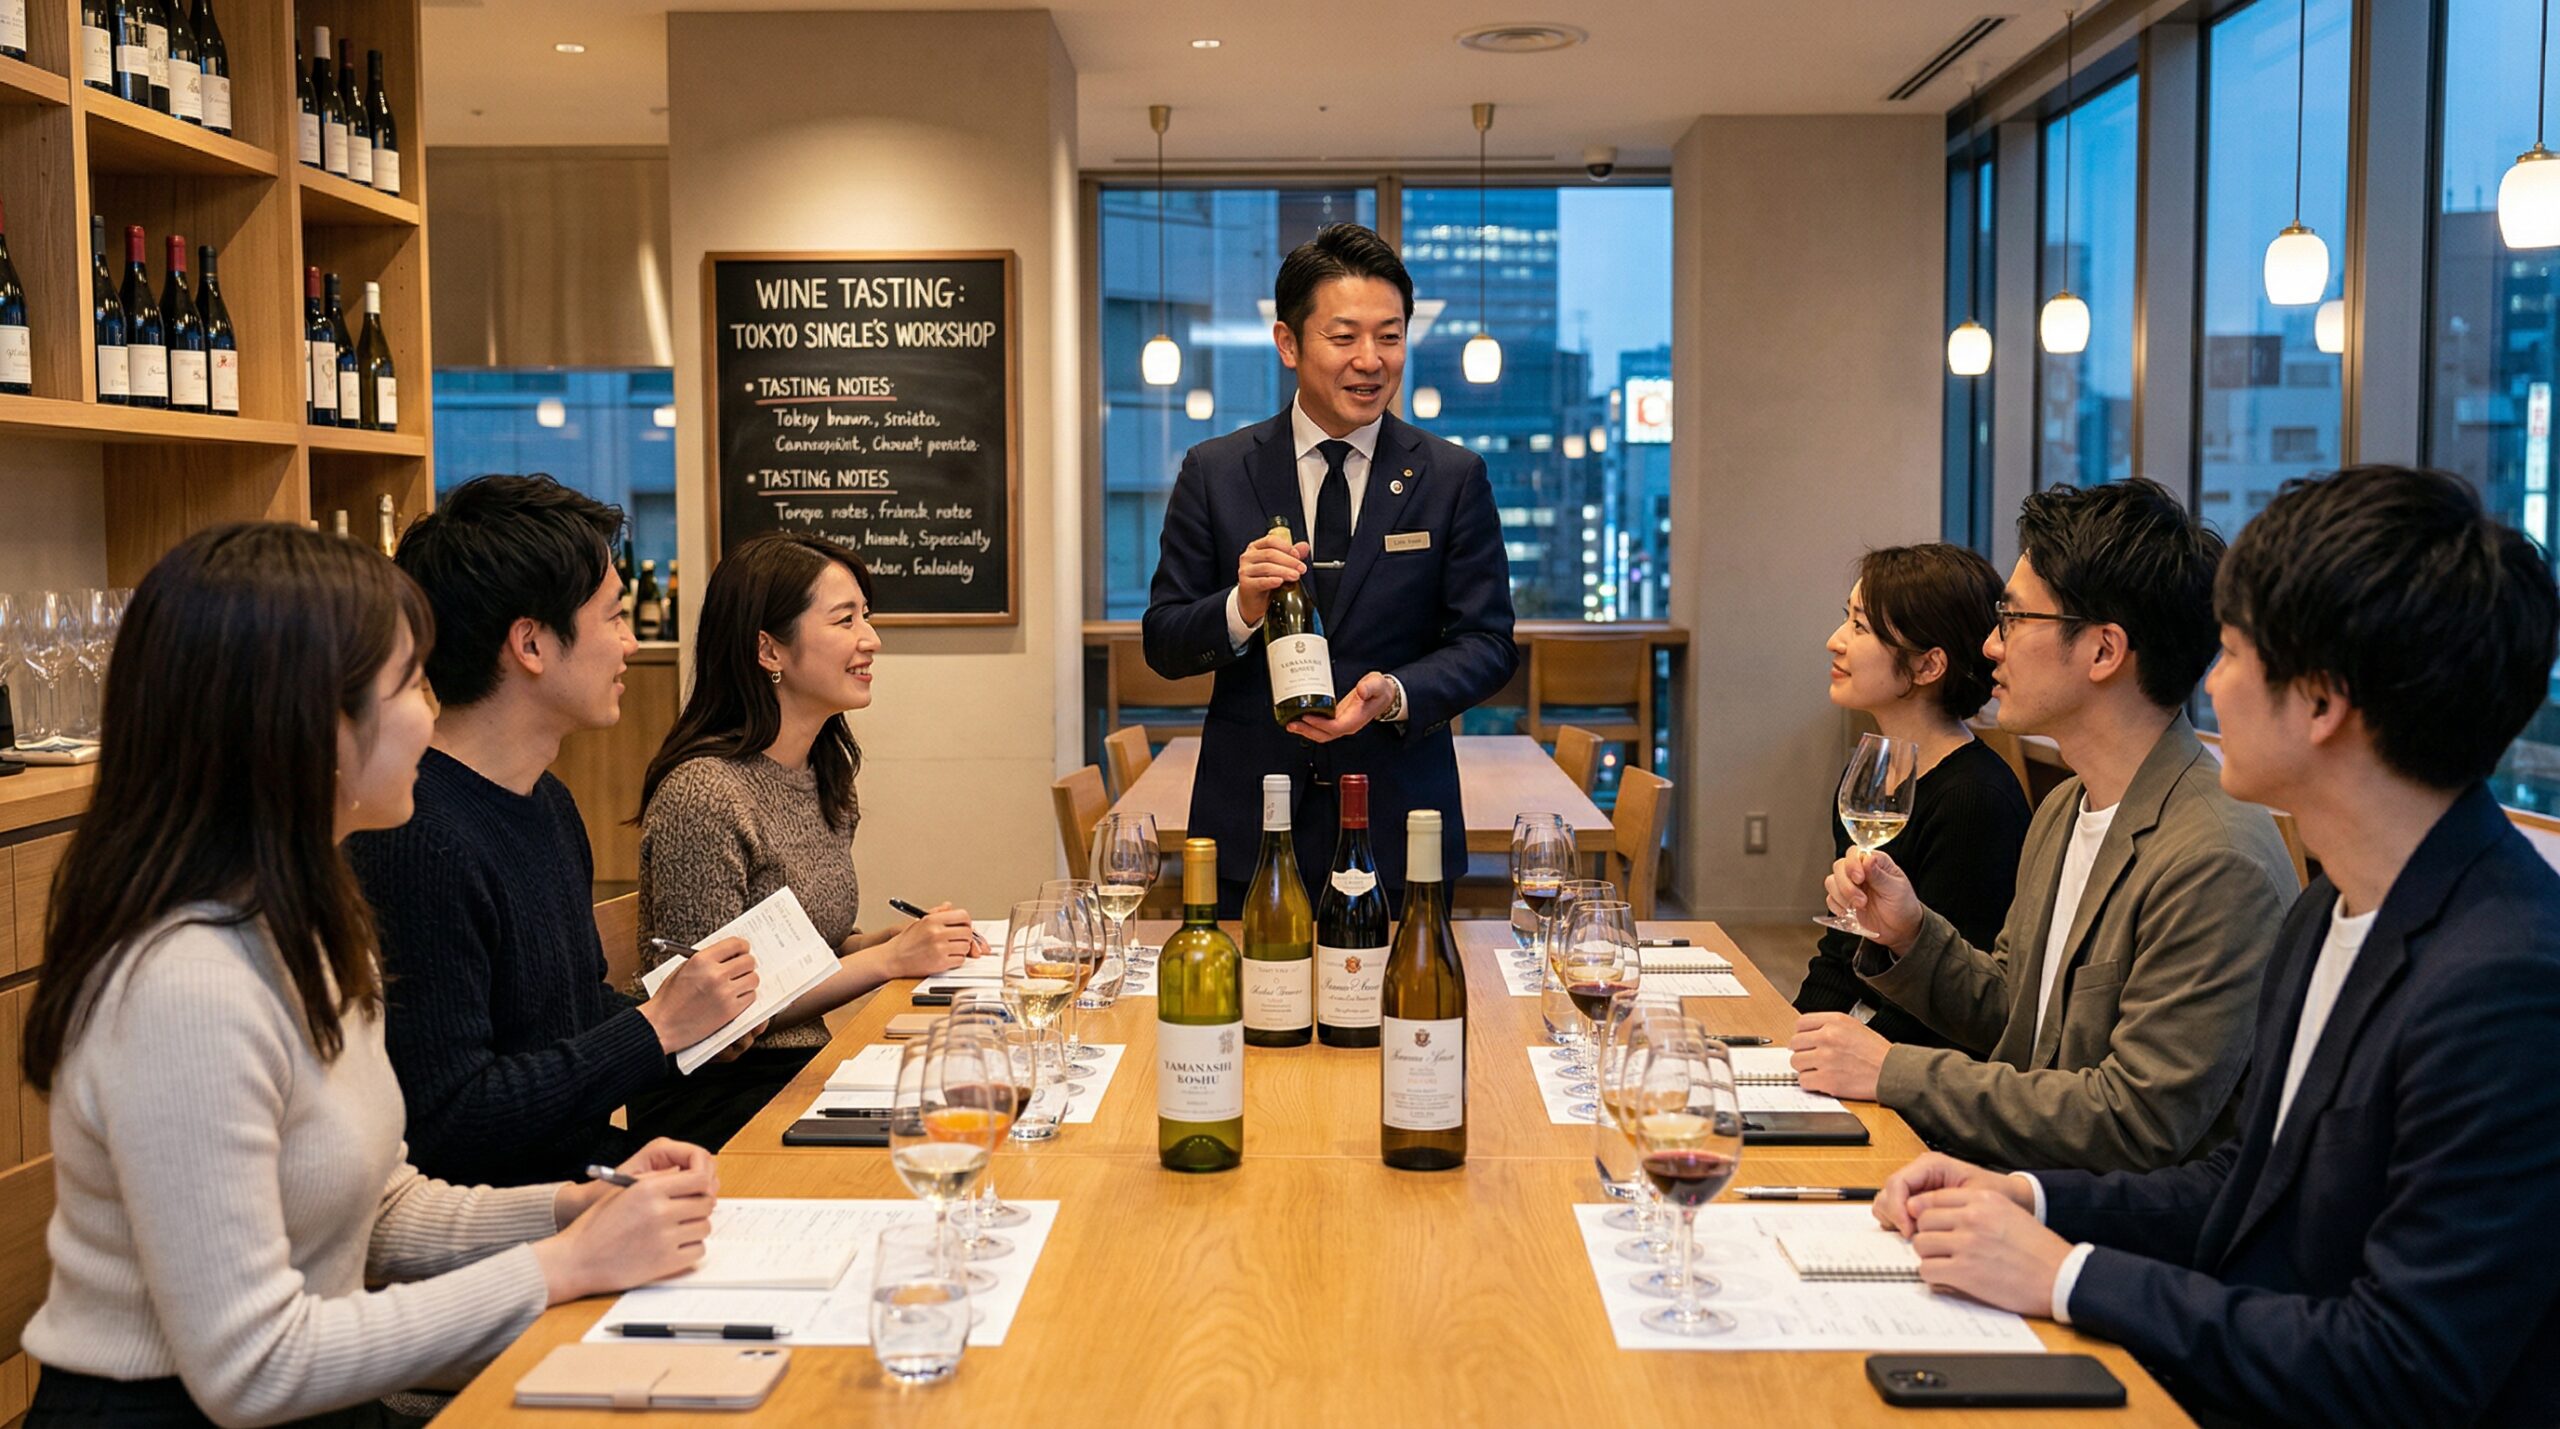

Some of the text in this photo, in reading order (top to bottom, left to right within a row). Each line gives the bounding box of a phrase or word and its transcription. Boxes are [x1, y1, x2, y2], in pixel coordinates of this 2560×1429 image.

[755, 278, 965, 309] WINE TASTING:
[730, 318, 996, 349] TOKYO SINGLE'S WORKSHOP
[758, 377, 830, 397] TASTING
[759, 469, 889, 488] TASTING NOTES
